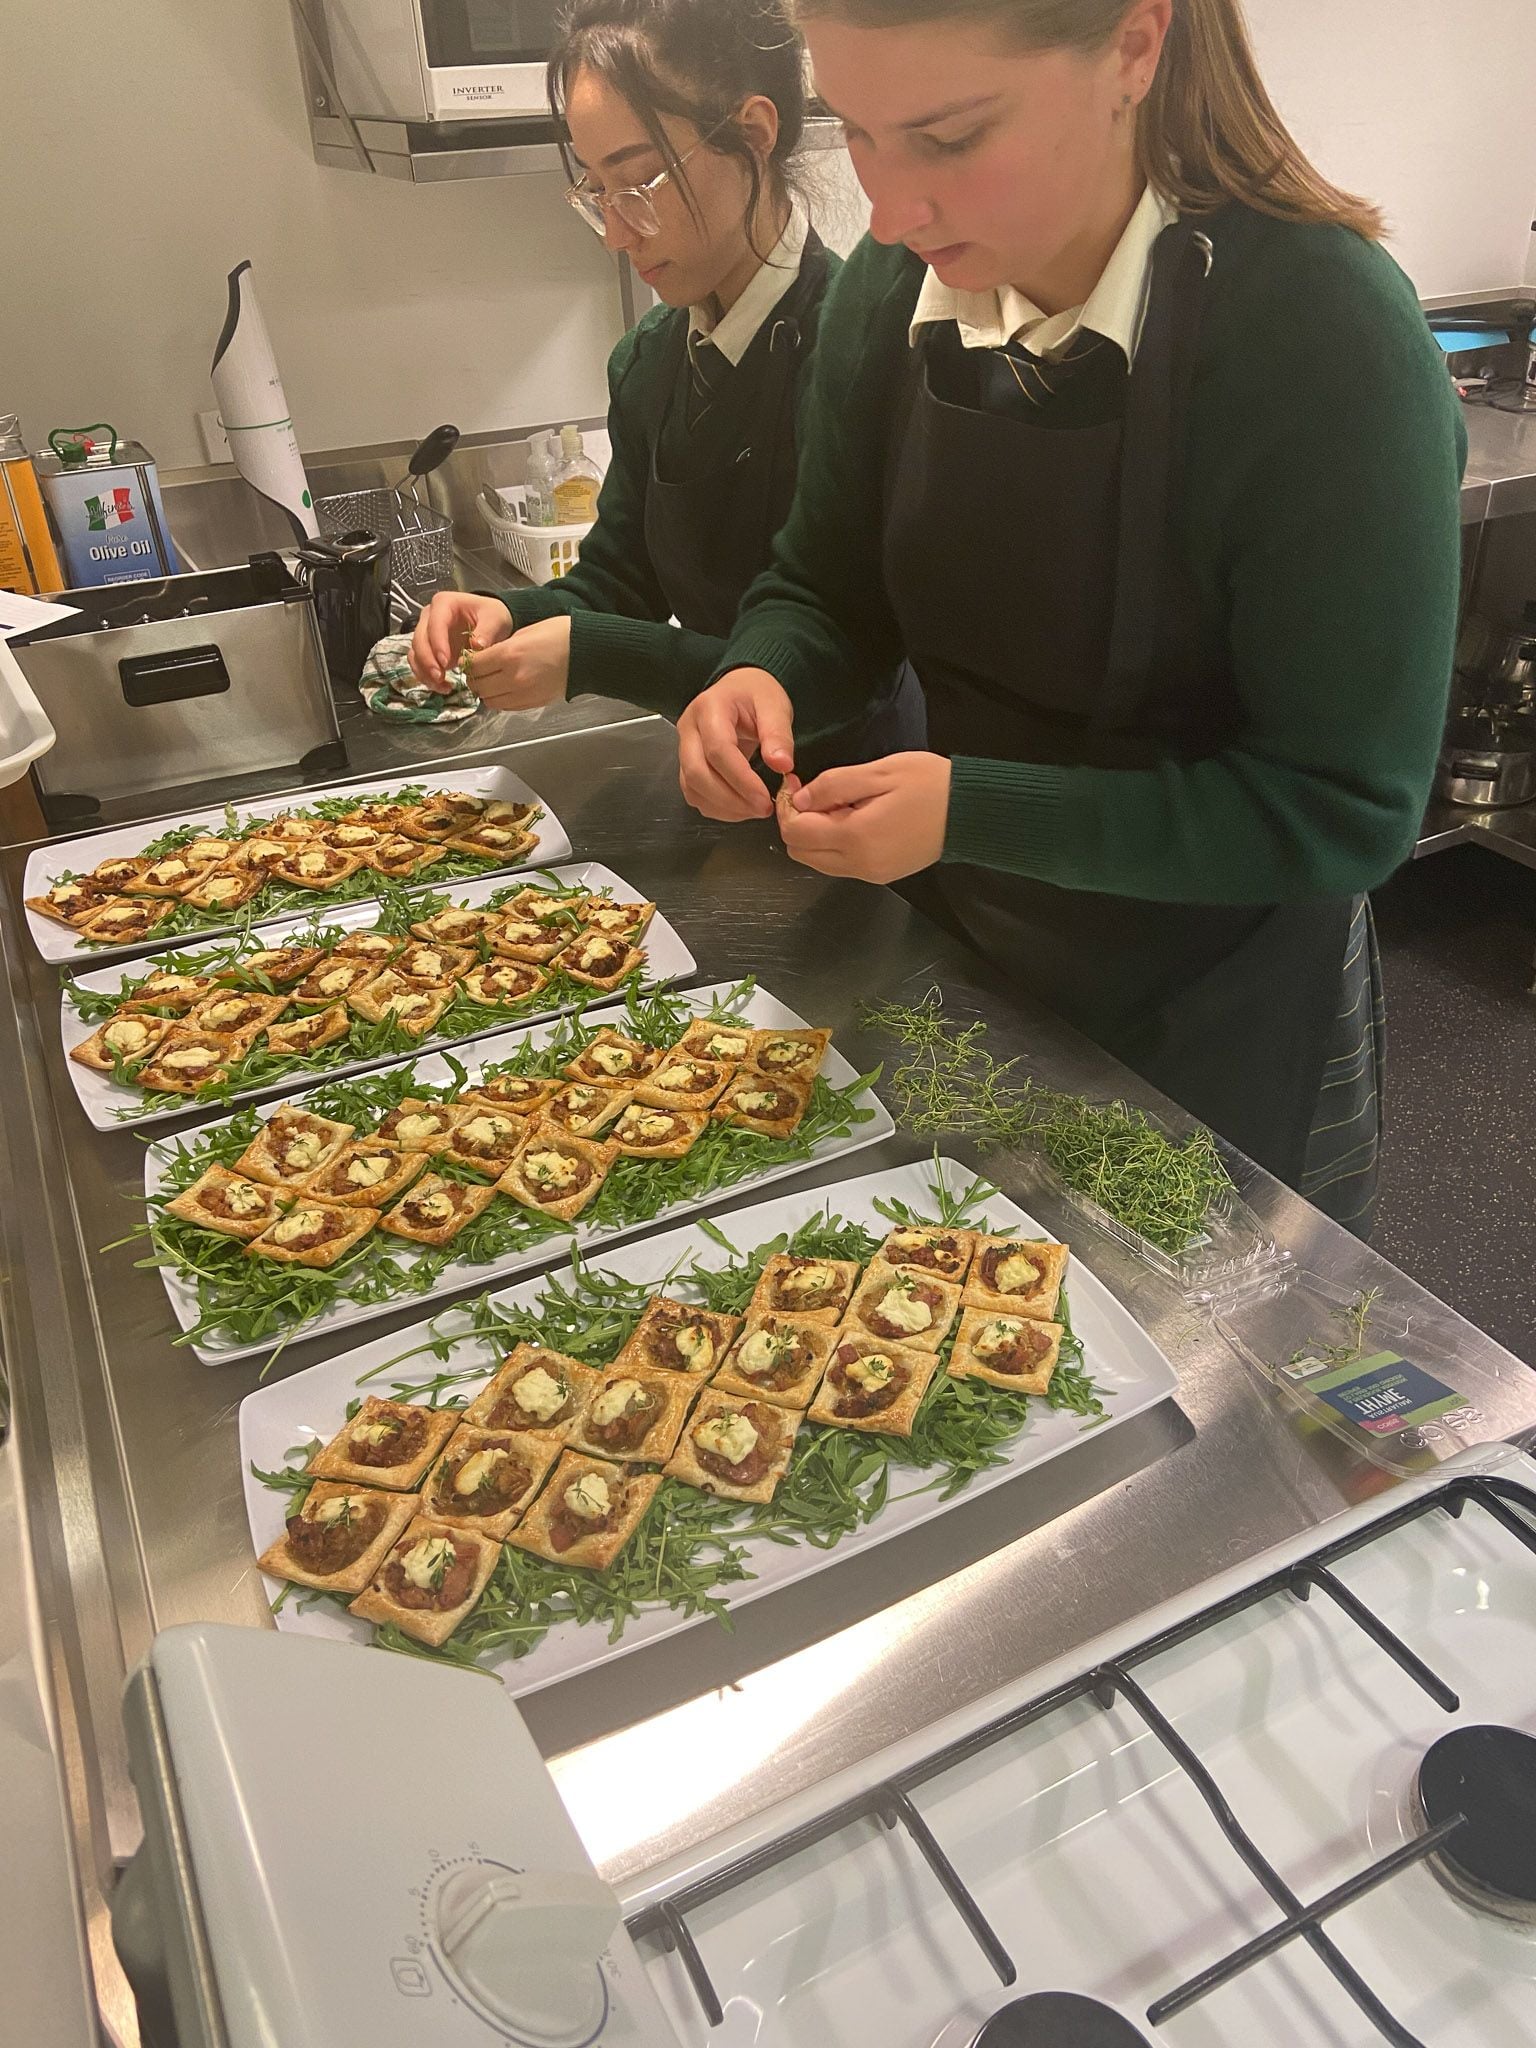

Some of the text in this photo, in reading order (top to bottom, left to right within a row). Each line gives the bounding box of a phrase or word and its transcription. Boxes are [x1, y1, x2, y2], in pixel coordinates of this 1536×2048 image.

[452, 85, 504, 95] INVERTER
[89, 540, 152, 561] Olive Oil
[427, 1848, 441, 1863] 10
[467, 1841, 481, 1856] 15
